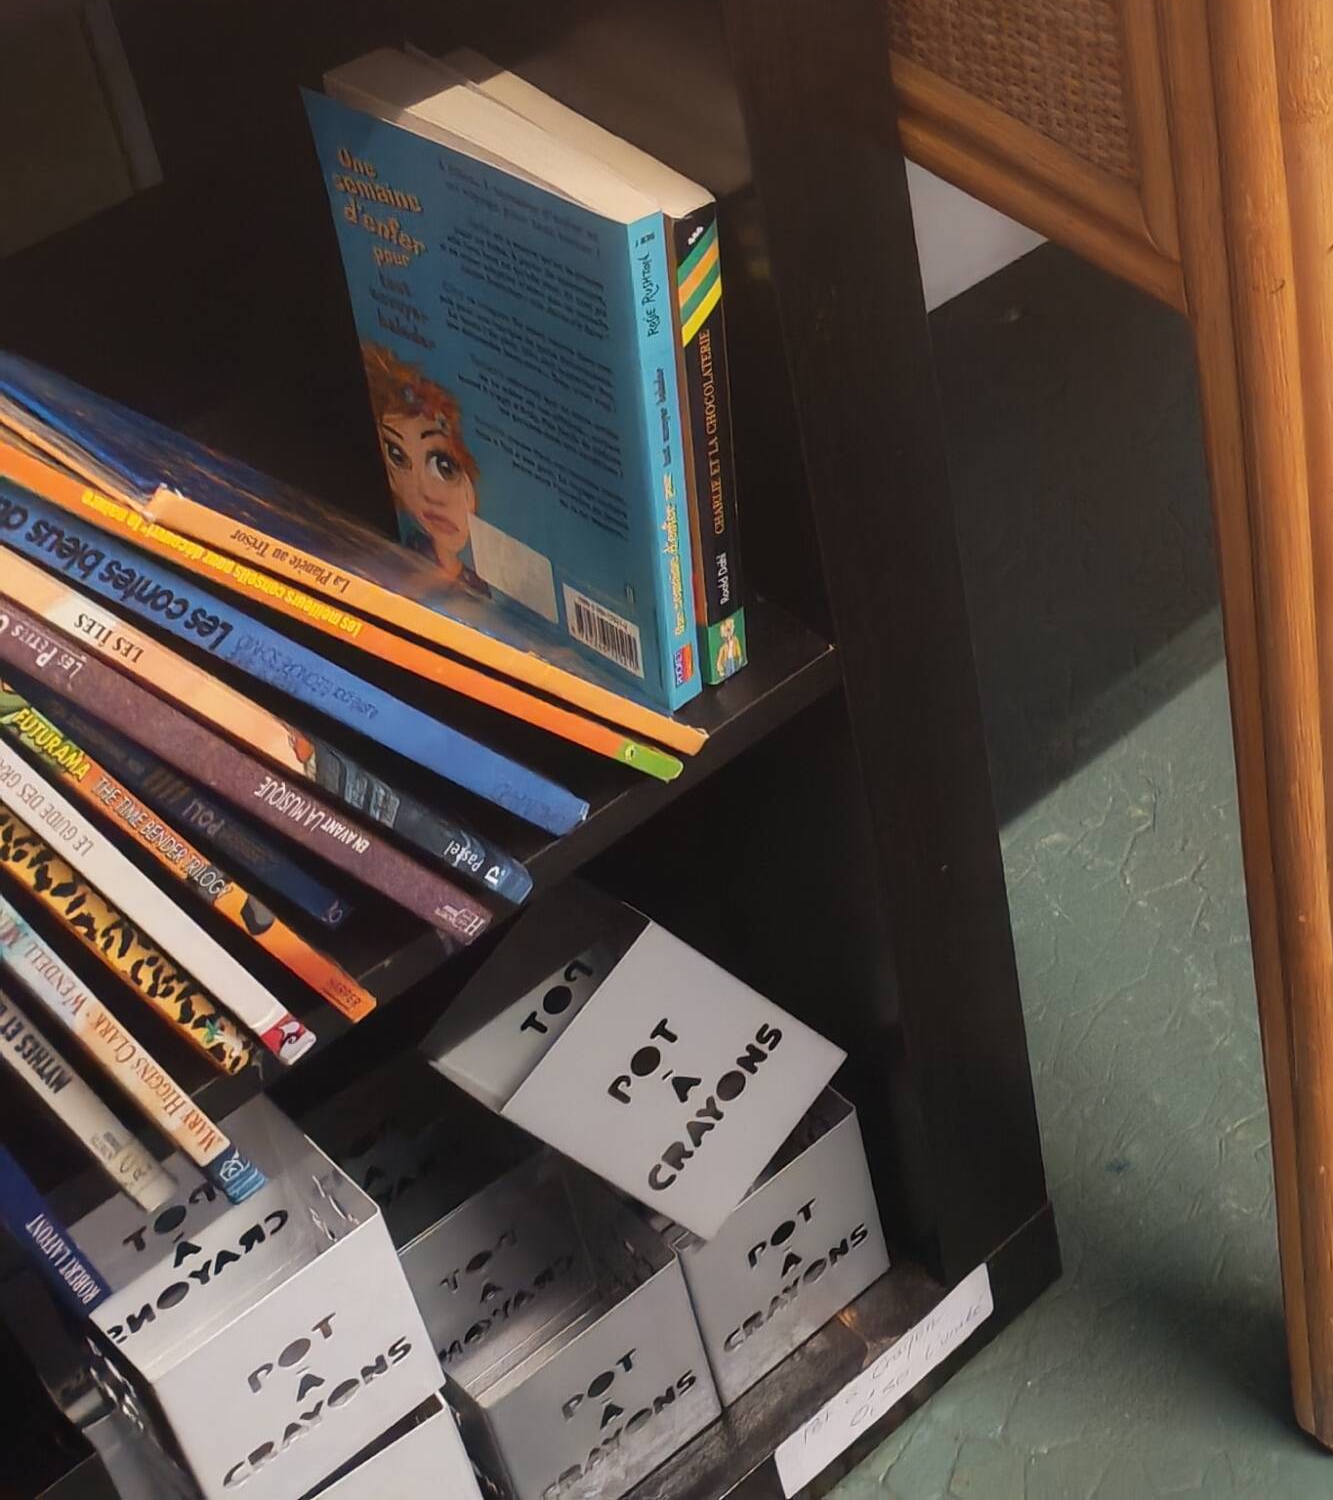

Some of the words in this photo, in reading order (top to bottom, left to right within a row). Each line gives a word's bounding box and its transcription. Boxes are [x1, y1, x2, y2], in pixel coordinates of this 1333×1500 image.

[698, 330, 719, 432] CHOCOLATERIE
[707, 437, 719, 452] LA
[709, 458, 721, 474] ET
[709, 477, 726, 533] CHARLIE
[19, 513, 105, 584] bleus
[202, 549, 235, 574] pour
[227, 527, 270, 557] Trésor
[271, 546, 289, 562] au
[231, 563, 286, 601] conseils
[286, 553, 332, 587] Planète
[331, 575, 350, 595] La
[714, 552, 728, 576] Dahl
[92, 553, 192, 631] contes
[283, 587, 341, 627] meilleurs
[70, 610, 113, 648] ÎLES
[180, 603, 234, 653] Les
[337, 614, 362, 638] Les
[111, 635, 144, 664] LES
[8, 705, 94, 779] FUTURAMA
[16, 780, 46, 810] DES
[253, 772, 313, 823] MUSIQUE
[38, 801, 79, 843] GUIDE
[89, 775, 122, 807] THE
[112, 794, 148, 830] TIME
[138, 817, 189, 865] BENDER
[179, 852, 233, 902] TRILOGY
[302, 806, 326, 832] LA
[319, 815, 357, 847] AVANT
[72, 834, 94, 856] LE
[351, 835, 371, 855] EN
[442, 837, 485, 876] Pastel
[18, 941, 90, 1015] WENDELL
[0, 1014, 26, 1040] ET
[87, 1011, 138, 1063] CLARK
[13, 1029, 73, 1096] MYTHES
[608, 1018, 678, 1104] POT
[128, 1054, 188, 1114] HIGGINS
[662, 1069, 702, 1103] À
[648, 1023, 783, 1190] CRAYONS
[179, 1107, 223, 1151] MARY
[21, 1211, 74, 1267] LAFFONT
[747, 1198, 816, 1269] POT
[57, 1256, 103, 1305] ROBERT
[723, 1222, 869, 1352] CRAYONS
[247, 1312, 336, 1394] POT
[296, 1366, 326, 1402] À
[561, 1347, 637, 1422] POT
[222, 1335, 412, 1488] CRAYONS
